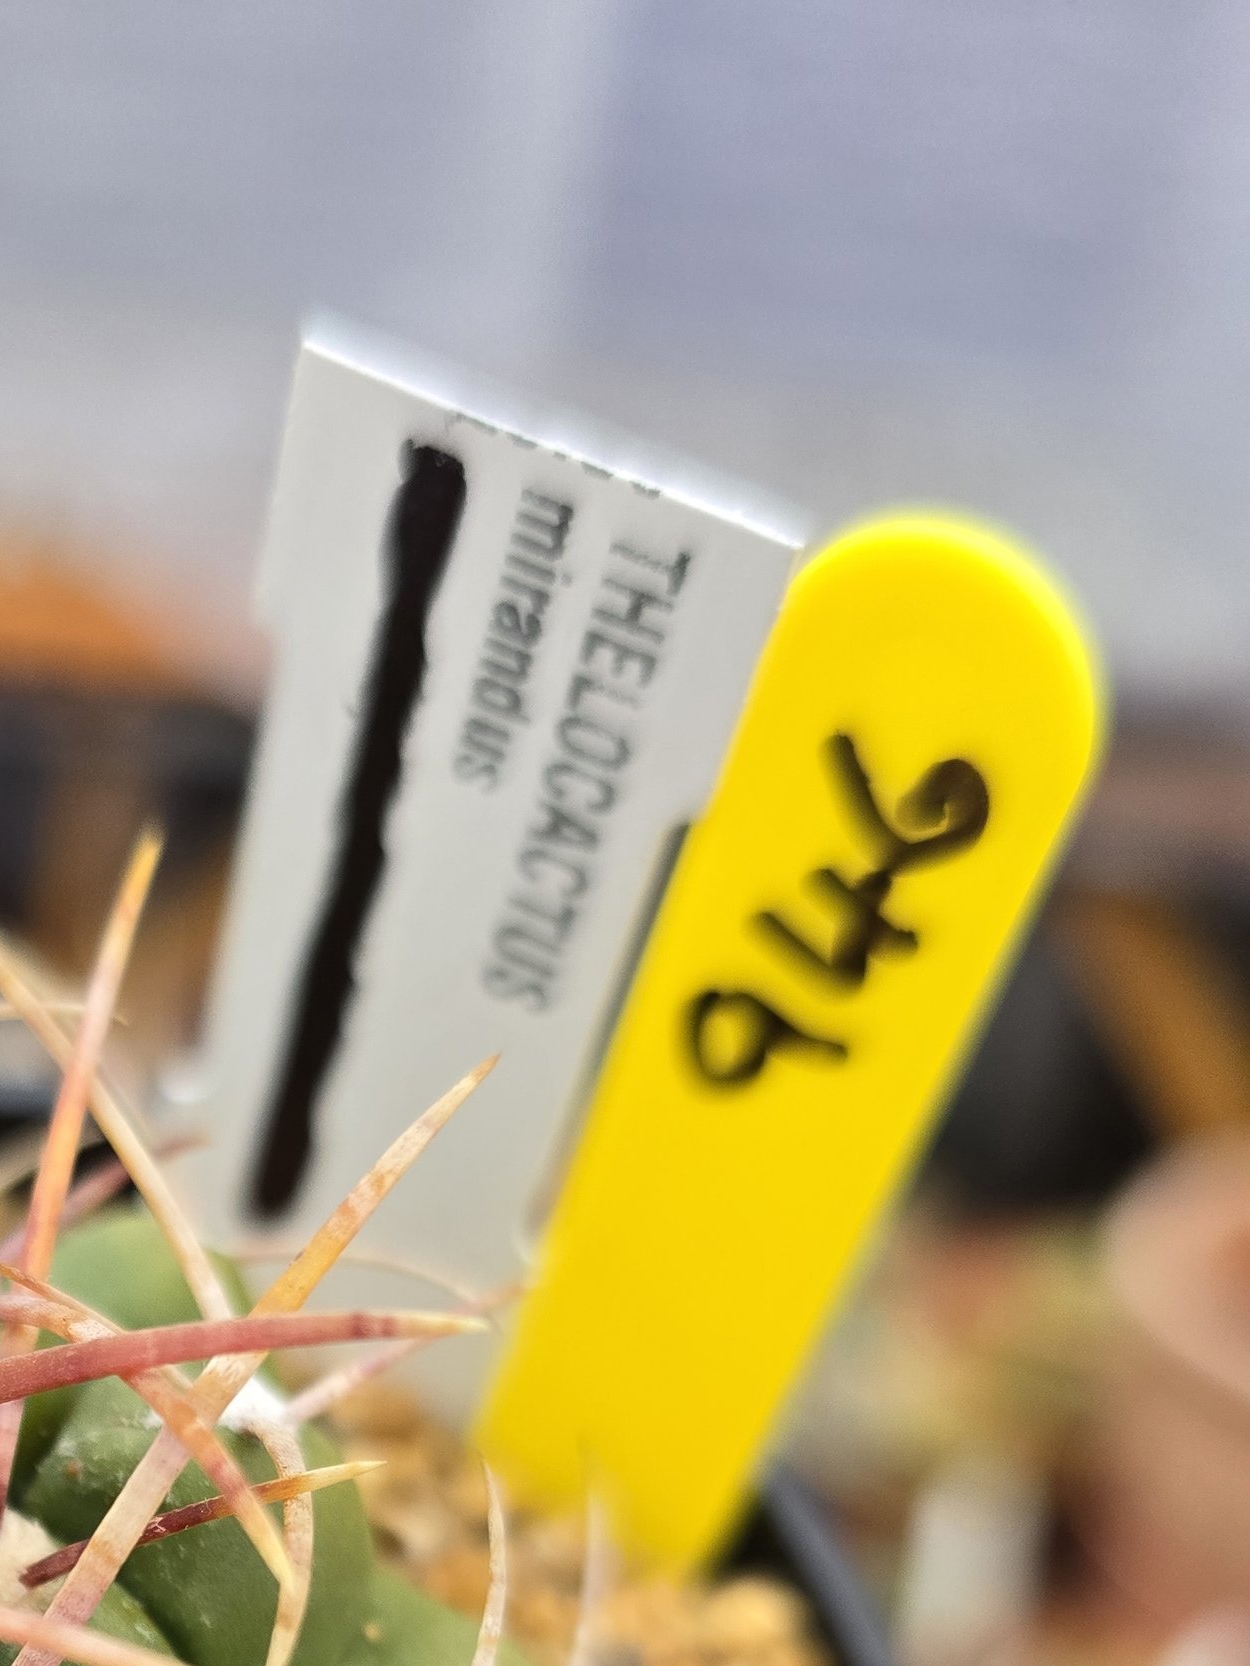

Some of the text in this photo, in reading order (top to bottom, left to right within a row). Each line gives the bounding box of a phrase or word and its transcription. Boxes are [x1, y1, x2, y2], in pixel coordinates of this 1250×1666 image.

[453, 487, 578, 790] mirandus
[481, 542, 692, 1014] THELOCACTUS
[690, 732, 989, 1086] 946
